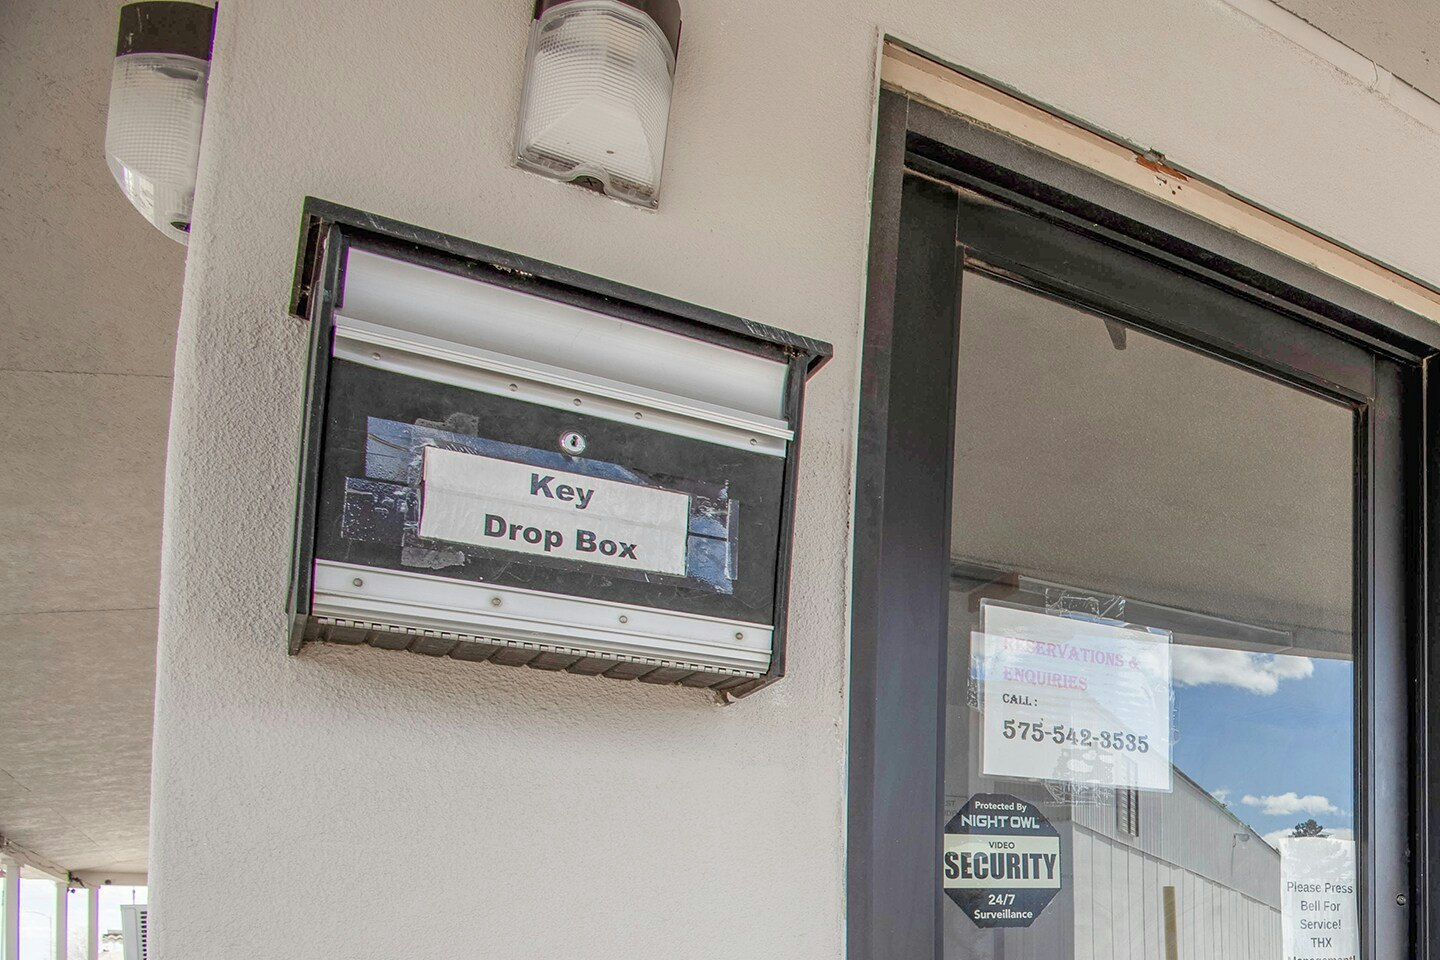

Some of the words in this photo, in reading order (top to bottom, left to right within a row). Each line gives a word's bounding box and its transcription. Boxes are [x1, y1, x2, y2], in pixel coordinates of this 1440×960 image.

[530, 472, 595, 509] Key
[484, 514, 563, 552] Drop
[576, 528, 638, 560] Box
[1003, 636, 1124, 667] RESERVATIONS
[1128, 656, 1140, 670] &
[1003, 666, 1088, 691] ENQUIRIES
[1002, 719, 1149, 753] 575-542-3535
[975, 801, 1014, 811] Protected
[1016, 803, 1027, 812] By
[961, 814, 1009, 829] NIGHT
[1010, 817, 1040, 829] OWL
[988, 841, 1015, 849] VIDEO
[944, 851, 1057, 880] SECURITY
[1287, 881, 1322, 893] Please
[1324, 883, 1353, 894] Press
[988, 893, 1016, 906] 24/7
[1300, 901, 1320, 912] Bell
[1323, 901, 1341, 912] For
[974, 909, 1033, 919] Surveillance
[1300, 919, 1341, 930] Service!
[1311, 937, 1332, 948] THX
